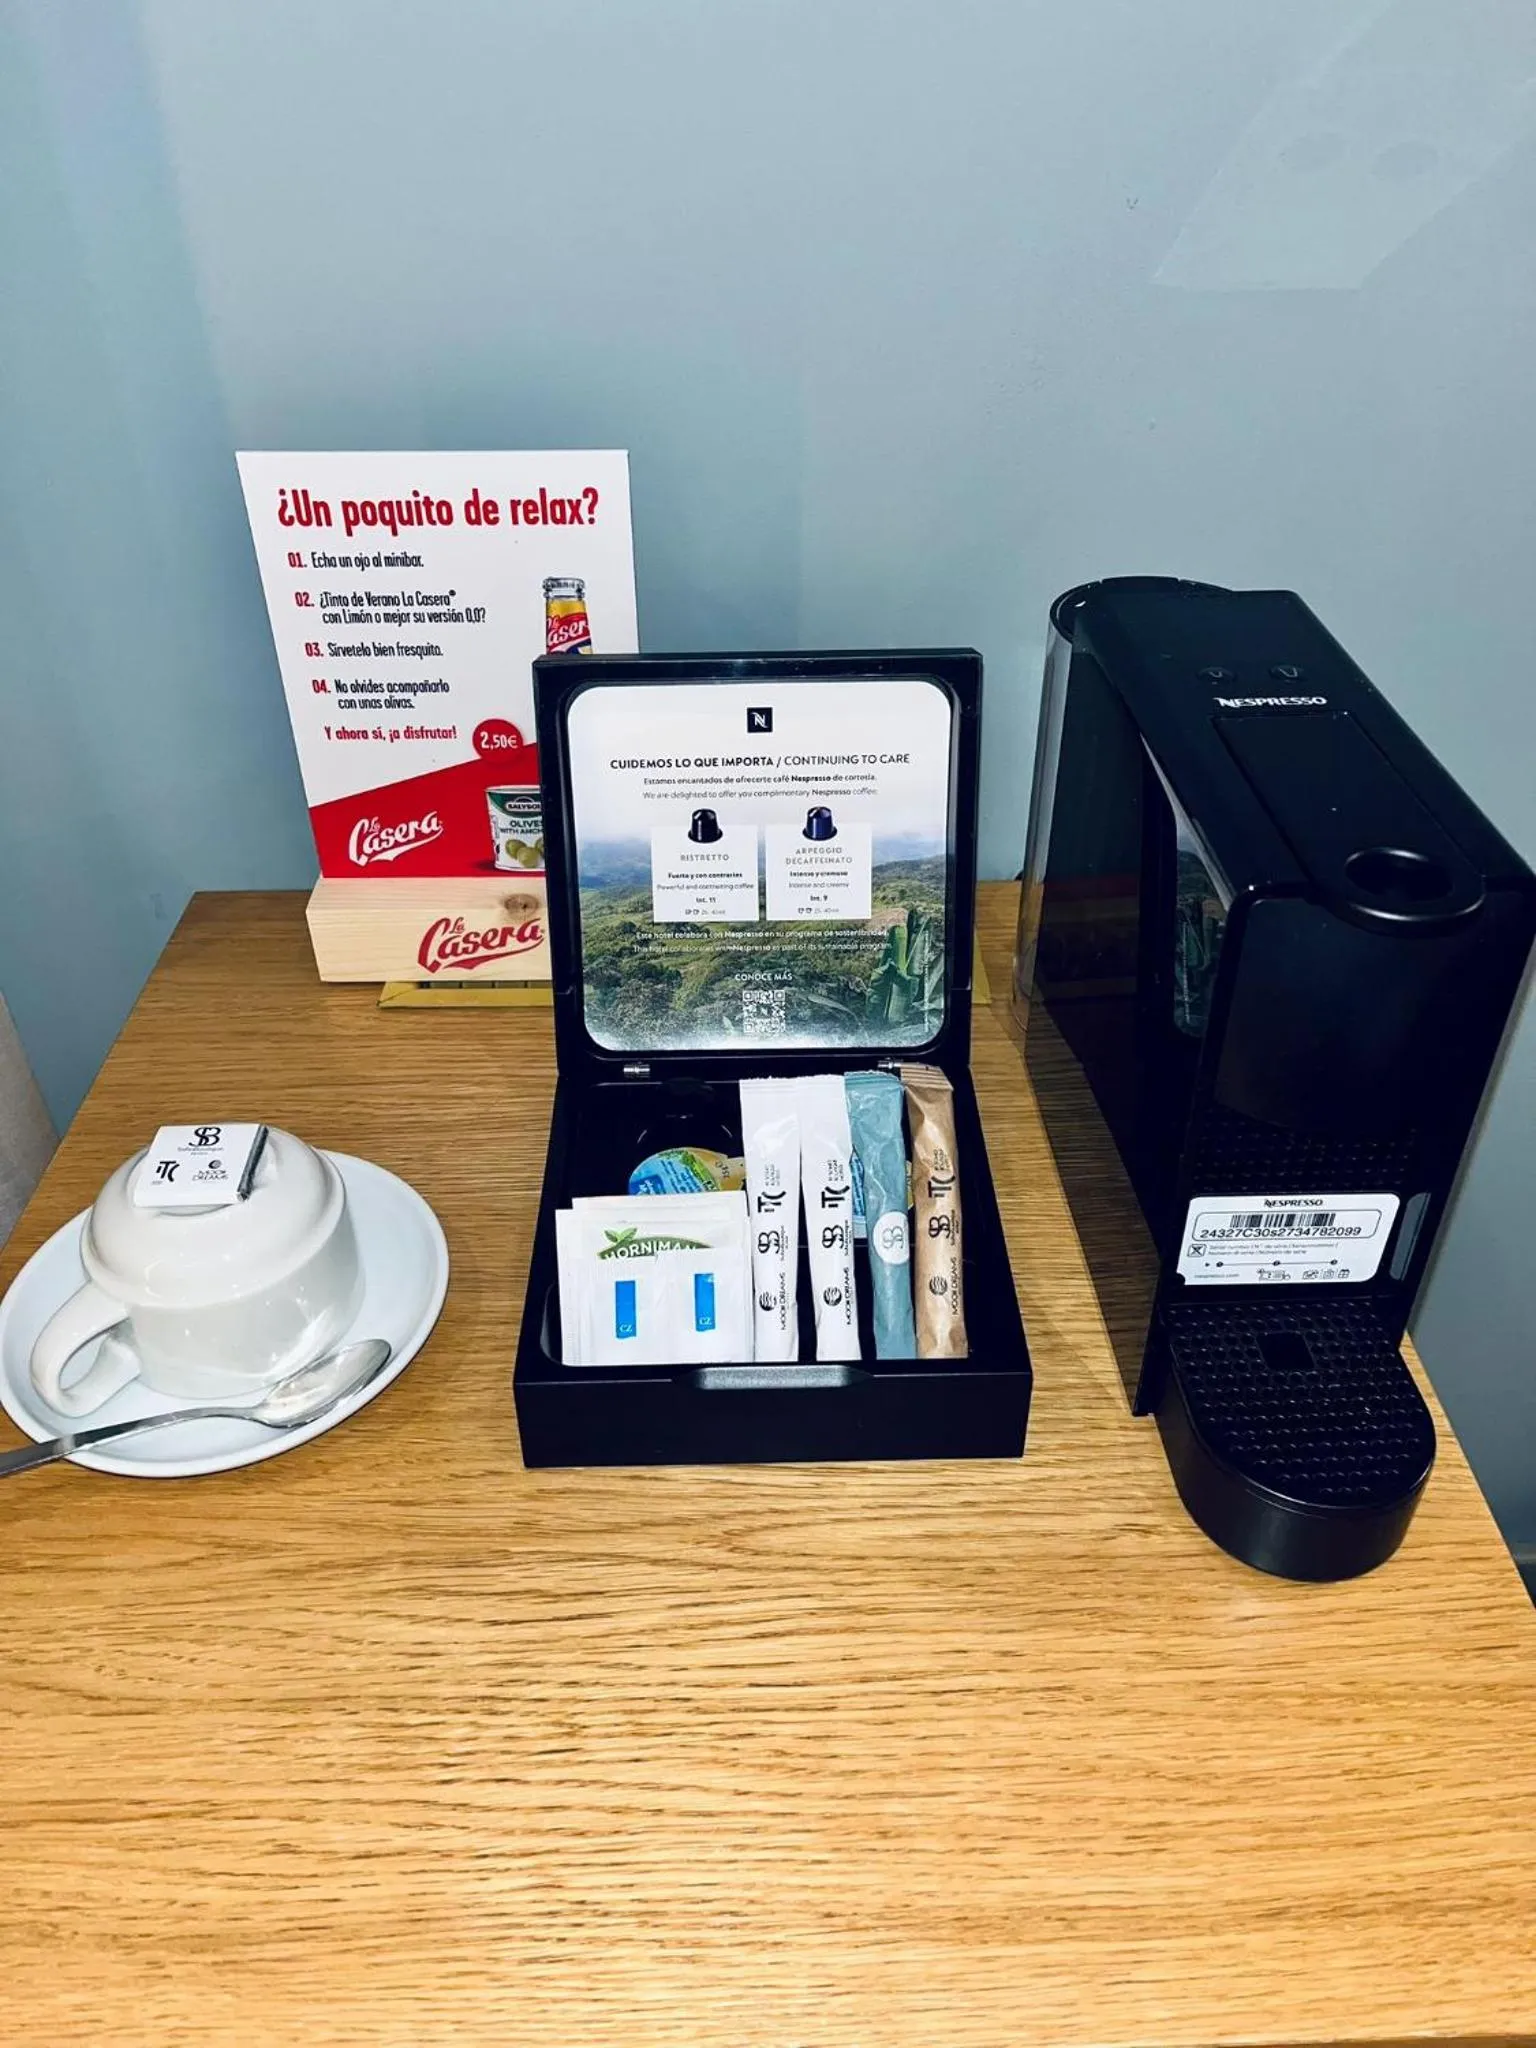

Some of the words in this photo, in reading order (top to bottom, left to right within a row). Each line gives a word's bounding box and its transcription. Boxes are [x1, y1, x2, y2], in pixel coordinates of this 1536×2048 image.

[278, 488, 333, 527] ¿Un
[341, 489, 454, 537] poquito
[464, 487, 500, 526] de
[509, 487, 599, 525] relax?
[287, 552, 308, 568] 01.
[311, 551, 338, 568] Echa
[338, 556, 353, 569] un
[354, 552, 371, 572] ojo
[372, 551, 383, 568] al
[384, 551, 424, 568] minibar.
[294, 592, 315, 607] 02.
[319, 591, 350, 609] ¿Tinto
[351, 591, 364, 607] de
[364, 591, 401, 607] Verano
[401, 590, 414, 606] La
[322, 611, 342, 624] con
[342, 608, 373, 624] Limón
[374, 612, 382, 624] o
[383, 609, 411, 627] mejor
[413, 611, 426, 623] su
[427, 608, 464, 623] versión
[305, 642, 325, 657] 03.
[372, 641, 395, 656] bien
[396, 641, 443, 660] fresquito.
[312, 679, 331, 693] 04.
[334, 679, 349, 693] No
[350, 678, 385, 693] olvides
[386, 678, 450, 696] acompañarlo
[338, 698, 357, 710] con
[358, 698, 383, 709] unas
[384, 695, 415, 710] olivas.
[1213, 696, 1328, 708] NESPRESSO
[324, 726, 332, 740] Y
[336, 726, 369, 740] ahora
[372, 726, 386, 741] sí,
[389, 727, 400, 743] ¡a
[403, 725, 458, 740] disfrutar!
[480, 731, 518, 750] 2,50€
[610, 758, 673, 769] CUIDEMOS
[675, 758, 691, 768] LO
[694, 757, 719, 768] QUE
[721, 757, 774, 767] IMPORTA
[784, 755, 859, 766] CONTINUING
[861, 754, 877, 764] TO
[879, 753, 910, 764] CARE
[643, 777, 676, 785] Estamos
[677, 776, 723, 785] encantados
[724, 776, 734, 784] de
[735, 775, 772, 784] ofrecerte
[773, 774, 790, 783] café
[791, 775, 832, 783] Nespresso
[832, 774, 843, 782] de
[718, 789, 737, 798] offer
[738, 790, 753, 799] you
[811, 787, 852, 796] Nespresso
[349, 811, 442, 867] Casera
[680, 853, 730, 862] RISTRETTO
[795, 847, 843, 855] ARPEGGIO
[785, 857, 853, 865] DECAFFEINATO
[418, 918, 544, 974] Casera
[735, 971, 772, 981] CONOCE
[773, 968, 793, 981] MÁS
[1263, 1199, 1324, 1208] NESPRESSO
